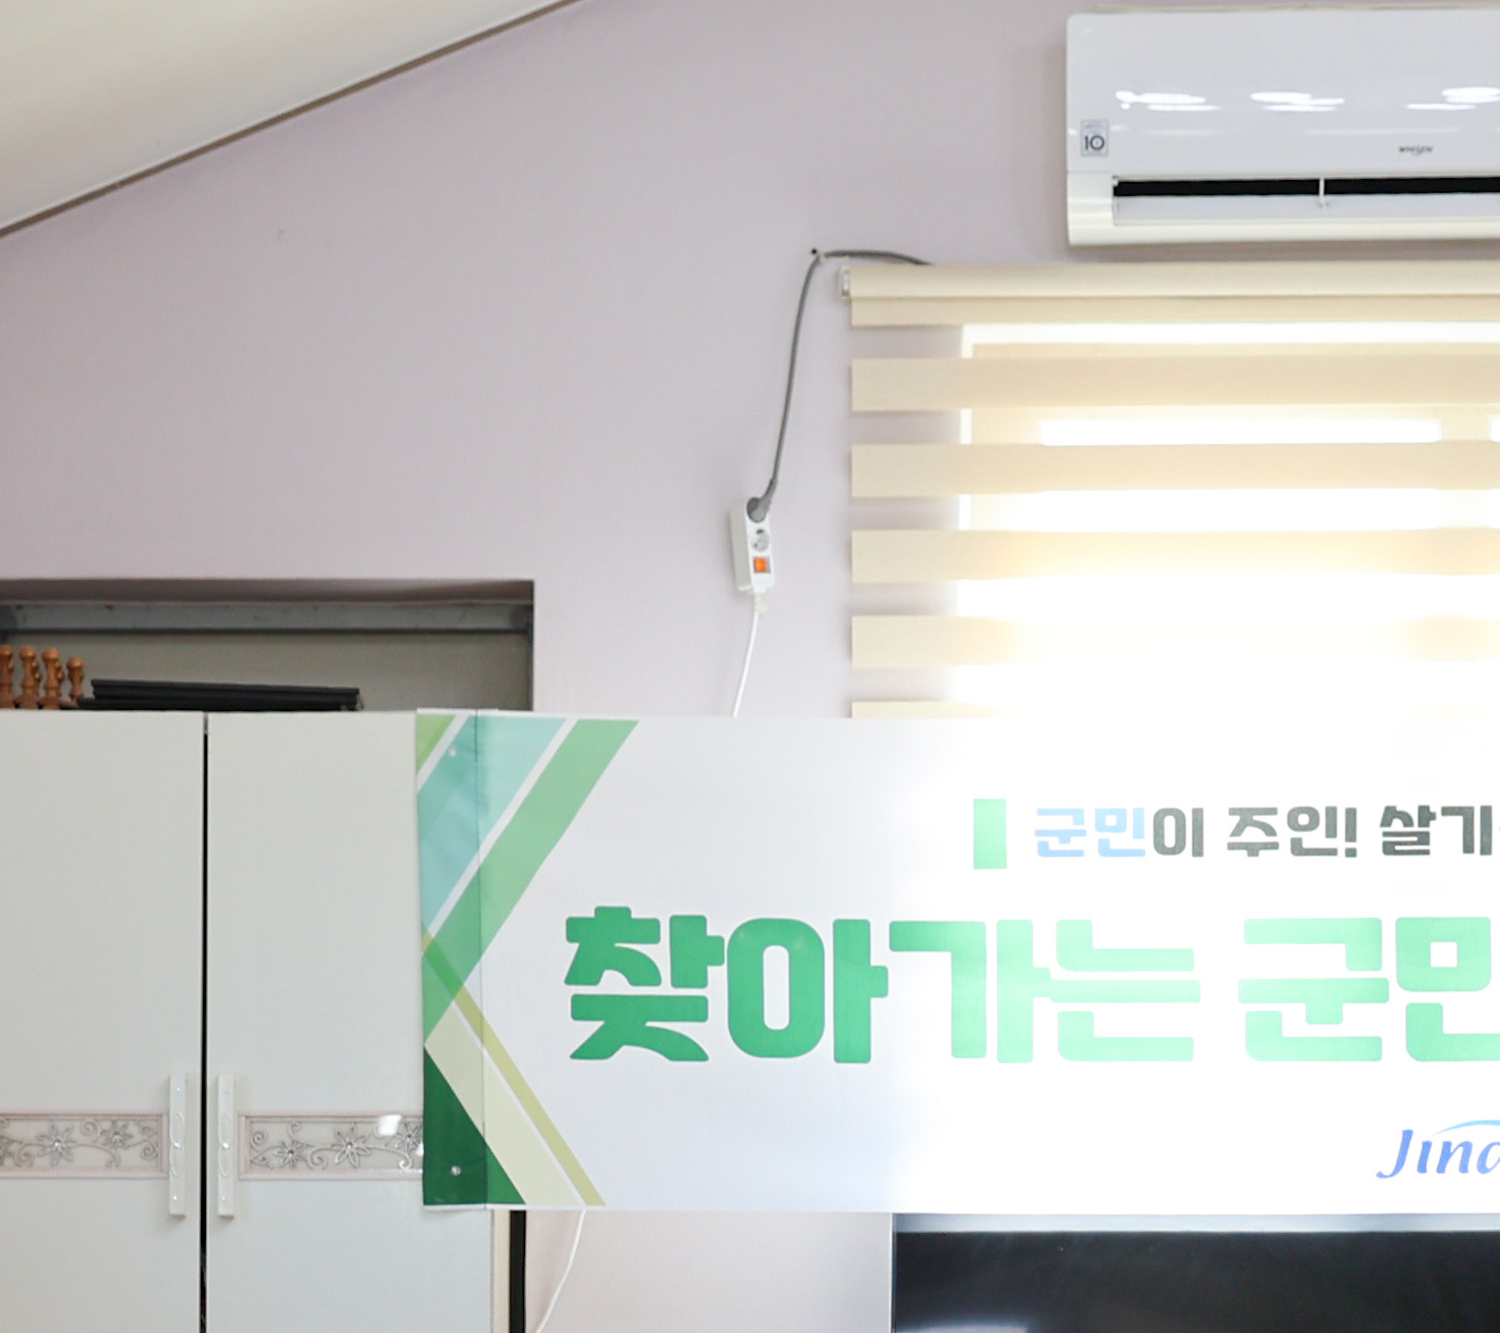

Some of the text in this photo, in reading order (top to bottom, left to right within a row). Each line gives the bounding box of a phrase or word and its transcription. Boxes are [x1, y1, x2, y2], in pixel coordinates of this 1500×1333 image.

[1084, 135, 1105, 151] 10
[1034, 806, 1204, 859] 군민이
[1226, 805, 1358, 859] 주인!
[563, 905, 1202, 1065] 찾아가는
